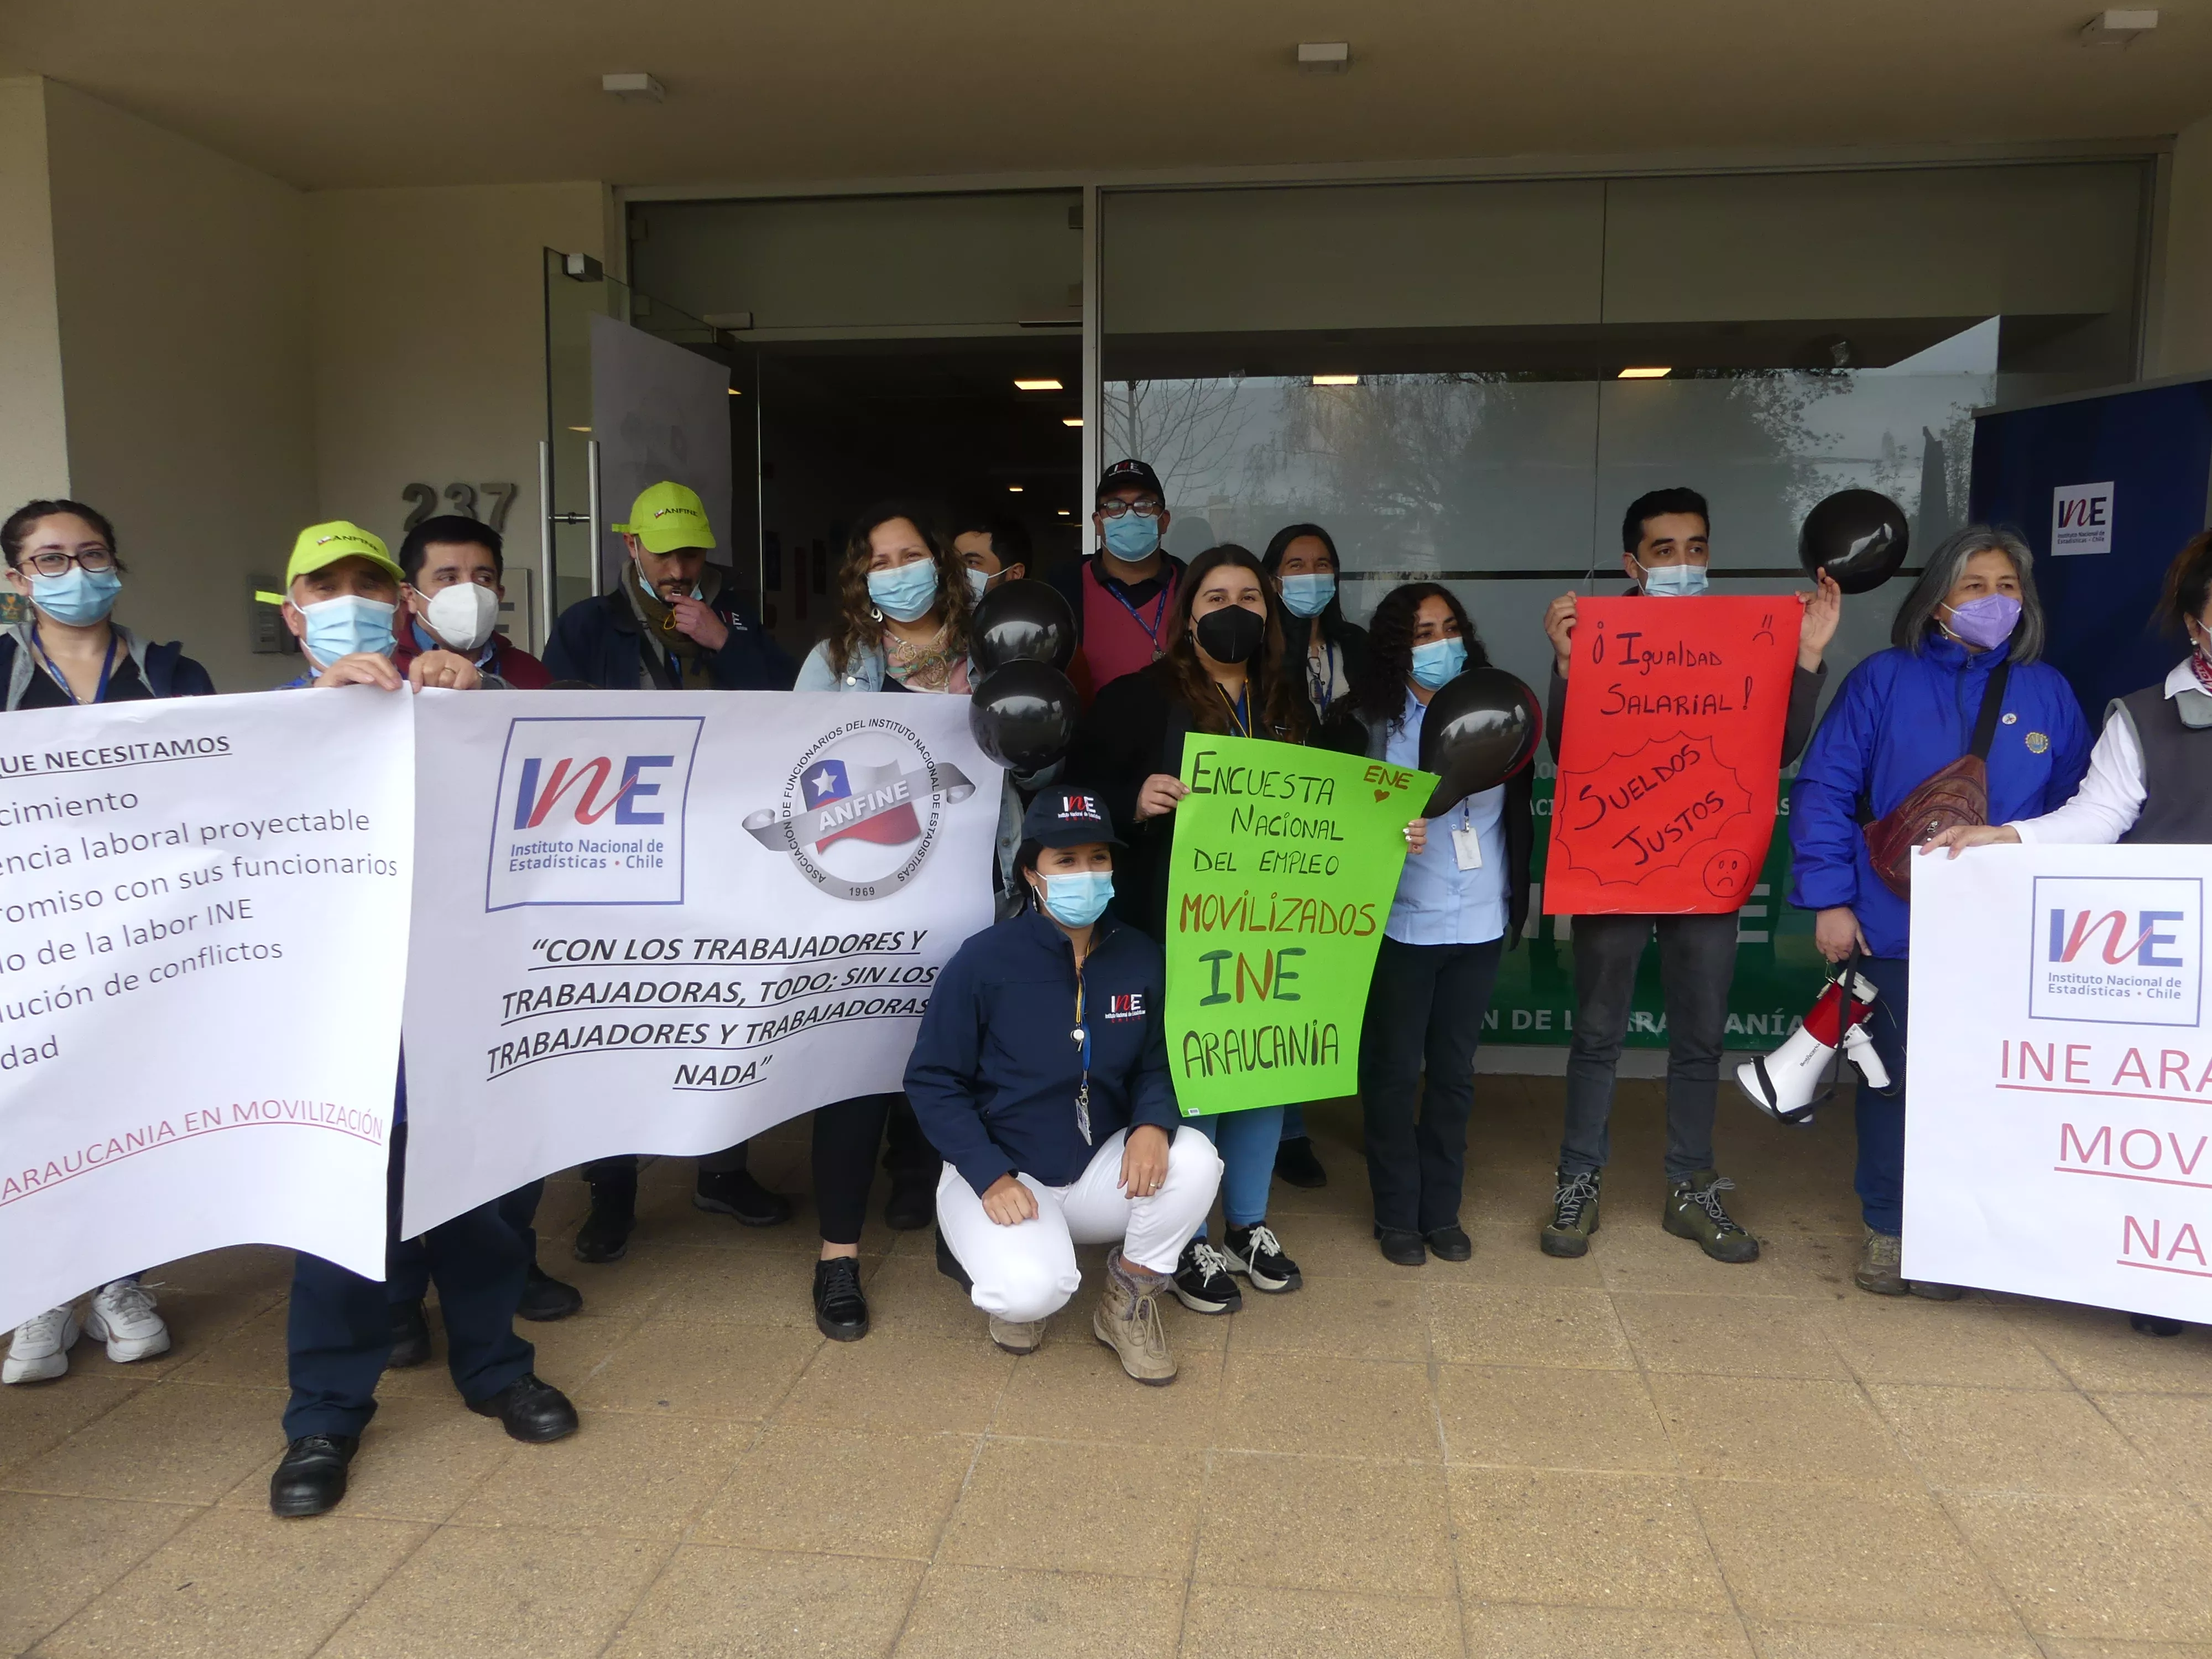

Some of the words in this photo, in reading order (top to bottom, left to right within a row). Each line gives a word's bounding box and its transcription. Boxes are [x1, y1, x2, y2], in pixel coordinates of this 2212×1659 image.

[665, 508, 698, 517] ANFINE
[846, 719, 867, 732] DEL
[868, 718, 915, 742] INSTITUTO
[45, 735, 230, 770] NECESITAMOS
[784, 727, 843, 798] FUNCIONARIOS
[914, 738, 939, 792] NACIONAL
[1191, 750, 1335, 805] ENCUESTA
[1363, 765, 1414, 790] ENE
[1574, 743, 1701, 831] SUELDOS
[0, 791, 139, 827] cimiento
[782, 801, 791, 817] DE
[819, 780, 910, 831] ANFINE
[933, 794, 941, 809] DE
[81, 823, 189, 860] laboral
[201, 808, 370, 845] proyectable
[510, 840, 573, 857] Instituto
[578, 839, 643, 854] Nacional
[647, 839, 664, 852] de
[897, 812, 939, 882] ESTADISTICAS
[1612, 790, 1724, 865] JUSTOS
[509, 854, 607, 872] Estadísticas
[626, 855, 664, 869] Chile
[783, 821, 827, 884] ASOCIACIÓN
[1193, 848, 1237, 872] DEL
[1259, 848, 1339, 876] EMPLEO
[0, 890, 103, 923] omiso
[114, 877, 169, 902] con
[179, 864, 223, 889] sus
[232, 852, 397, 879] funcionarios
[848, 886, 875, 896] 1969
[38, 940, 76, 965] de
[86, 931, 113, 955] la
[123, 912, 198, 947] labor
[207, 899, 254, 928] INE
[624, 938, 683, 961] LOS
[692, 931, 905, 960] TRABAJADORES
[911, 930, 928, 950] Y
[105, 972, 139, 996] de
[149, 941, 284, 984] conflictos
[1198, 947, 1306, 1006] INE
[2048, 972, 2103, 985] Instituto
[2106, 975, 2162, 987] Nacional
[2166, 977, 2182, 988] de
[503, 981, 747, 1019] TRABAJADORAS,
[760, 973, 838, 1003] TODO;
[846, 966, 888, 986] SIN
[888, 966, 940, 983] LOS
[2048, 983, 2131, 998] Estadísticas
[2147, 988, 2182, 999] Chile
[487, 1022, 709, 1074] TRABAJADORES
[721, 1024, 740, 1045] Y
[747, 998, 929, 1044] TRABAJADORAS
[1512, 1009, 1552, 1030] DE
[1, 1034, 59, 1070] dad
[2001, 1040, 2092, 1084] INE
[2, 1120, 176, 1201] ARAUCANIA
[185, 1107, 222, 1133] EN
[233, 1099, 383, 1140] MOVILIZACIÓN
